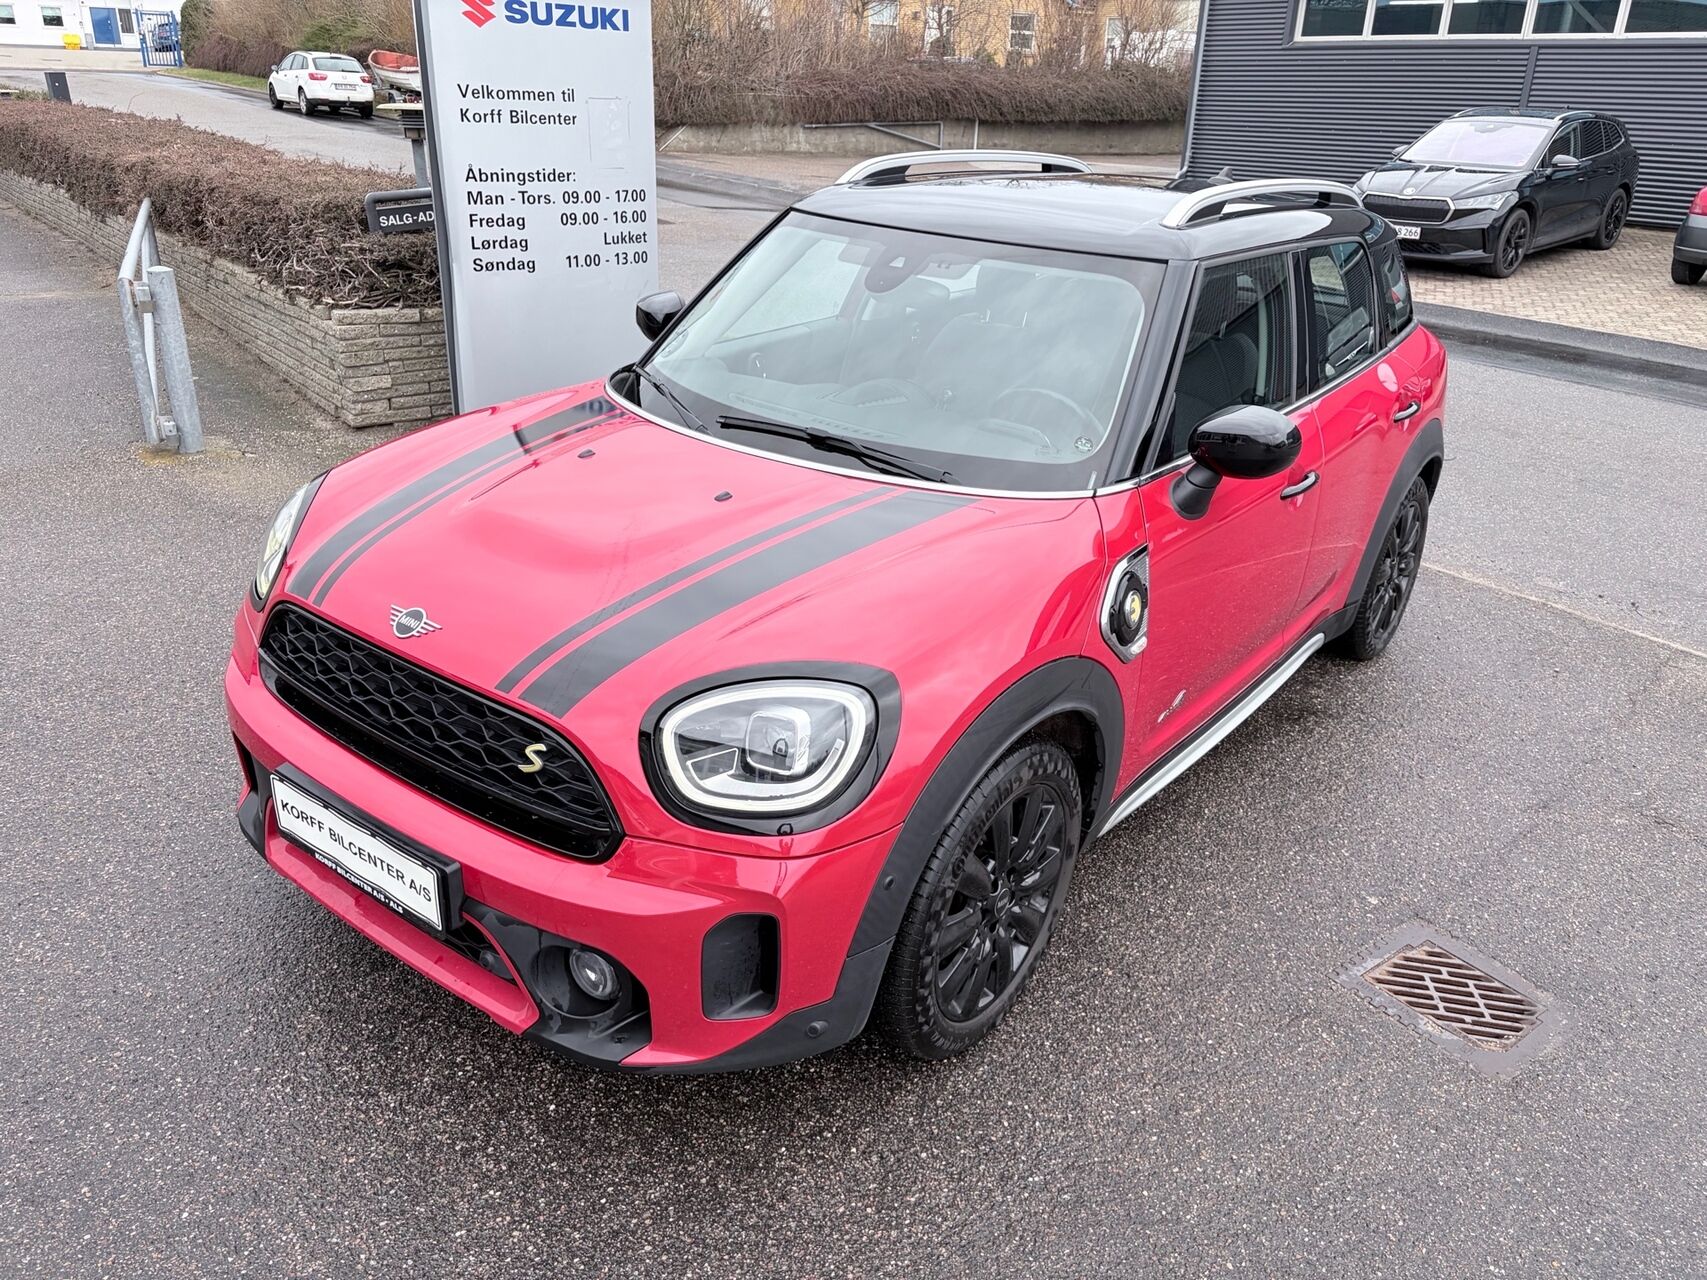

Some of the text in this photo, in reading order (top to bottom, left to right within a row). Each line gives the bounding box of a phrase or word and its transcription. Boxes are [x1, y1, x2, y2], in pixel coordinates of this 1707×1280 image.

[504, 0, 630, 32] SUZUKI
[457, 84, 574, 102] Velkommen til
[460, 108, 577, 125] Korff Bilcenter
[466, 164, 576, 186] Åbningstider:
[467, 191, 504, 205] Man
[563, 191, 600, 204] 09.00
[615, 189, 646, 202] 17.00
[469, 213, 525, 230] Fredag
[561, 212, 598, 226] 09.00
[613, 210, 646, 223] 16.00
[471, 231, 647, 252] Lørdag Lukket
[1403, 228, 1419, 237] 266
[473, 257, 535, 273] Søndag
[566, 254, 600, 268] 11.00
[615, 251, 648, 265] 13.00
[399, 615, 420, 629] MINI
[518, 744, 547, 773] S
[280, 799, 431, 902] KORFF BILCENTER A/S
[315, 852, 336, 869] KORFF
[336, 866, 373, 895] BILCENTER
